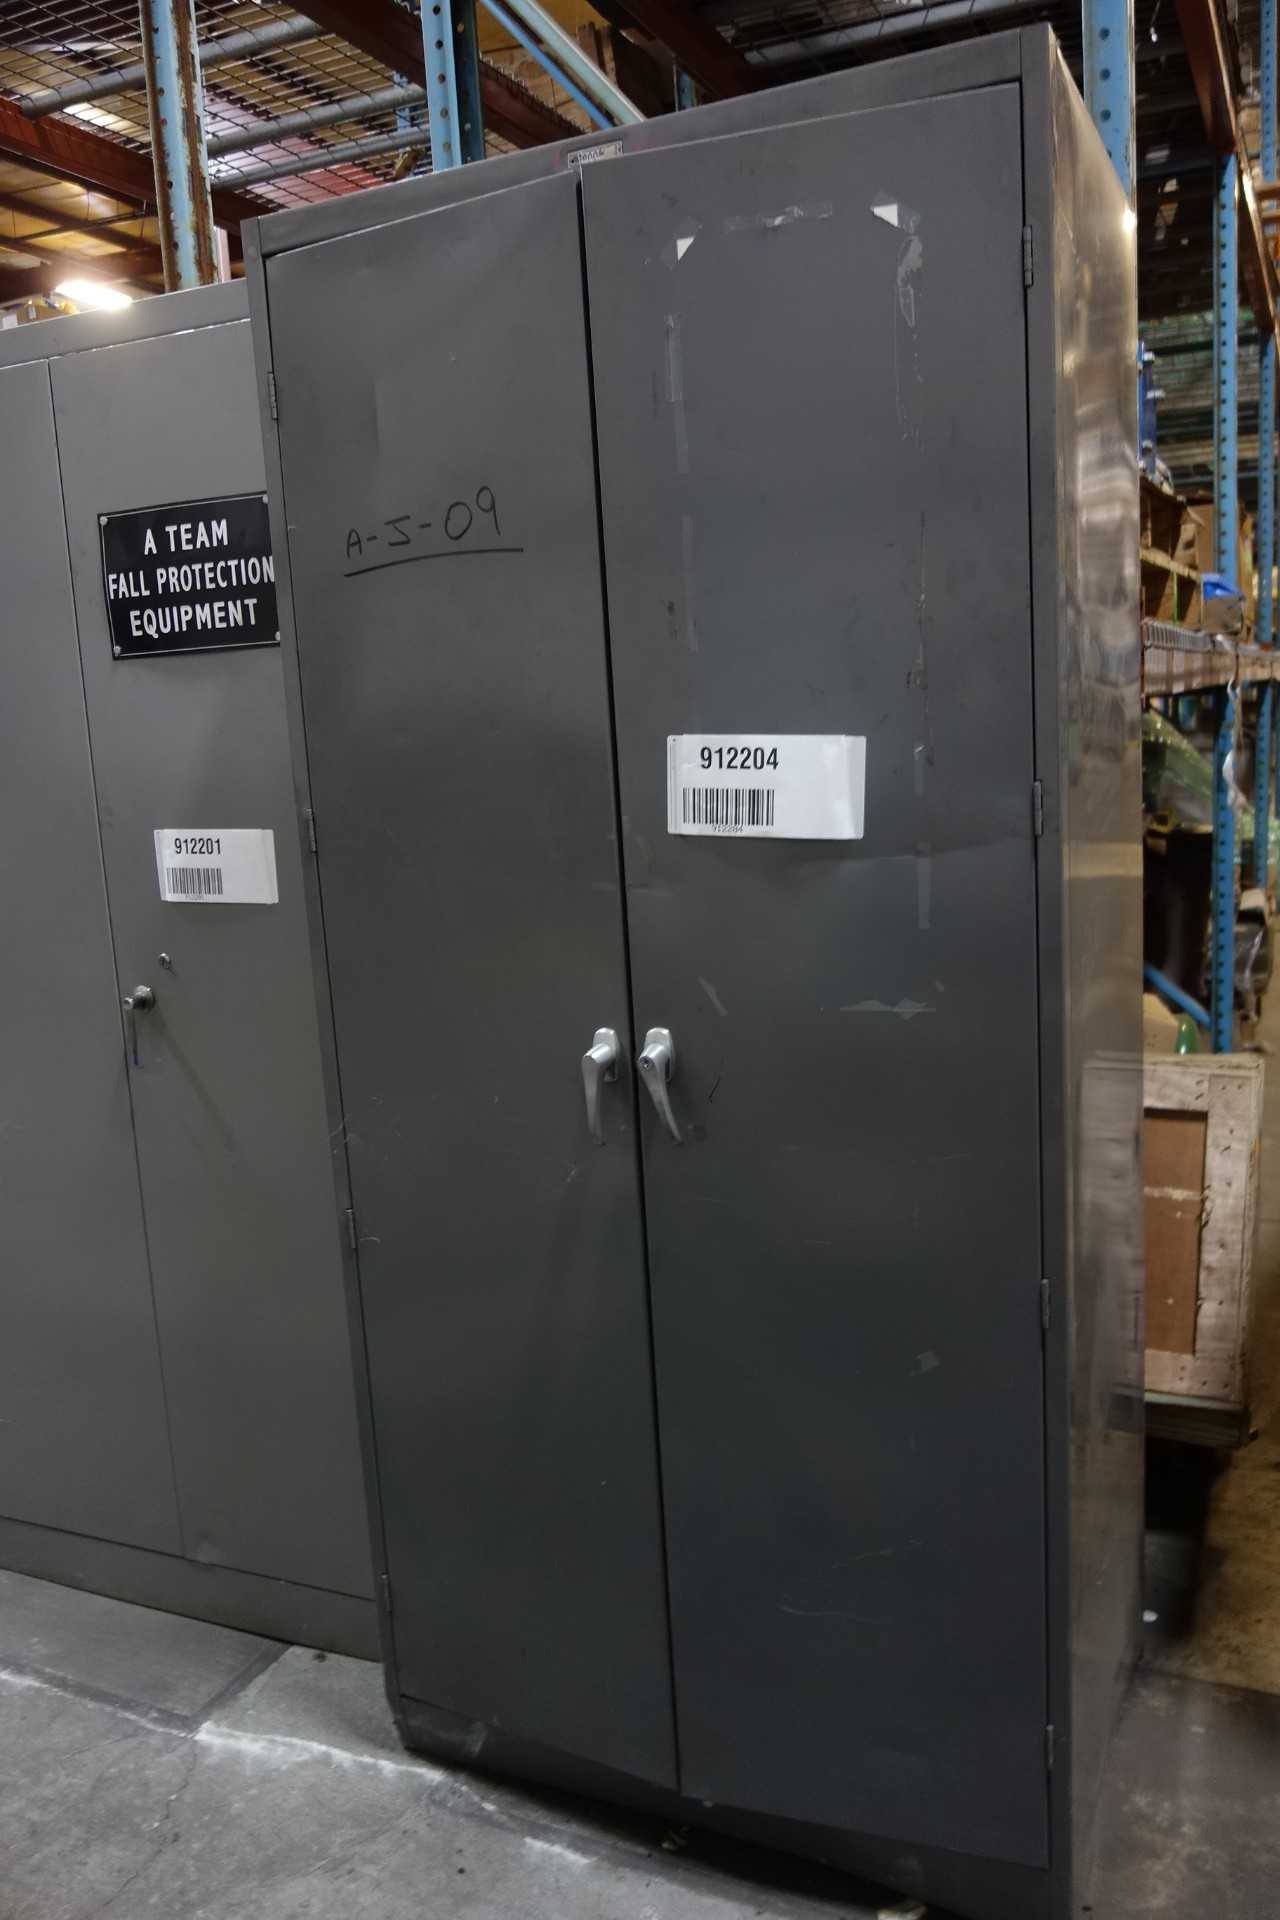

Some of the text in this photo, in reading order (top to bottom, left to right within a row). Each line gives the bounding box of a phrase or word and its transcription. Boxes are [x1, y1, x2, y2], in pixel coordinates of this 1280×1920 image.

[144, 518, 229, 555] A TEAM
[108, 556, 275, 600] FALL PROTECTION
[129, 598, 257, 639] EQUIPMENT
[700, 747, 779, 770] 912204
[174, 838, 221, 855] 912201
